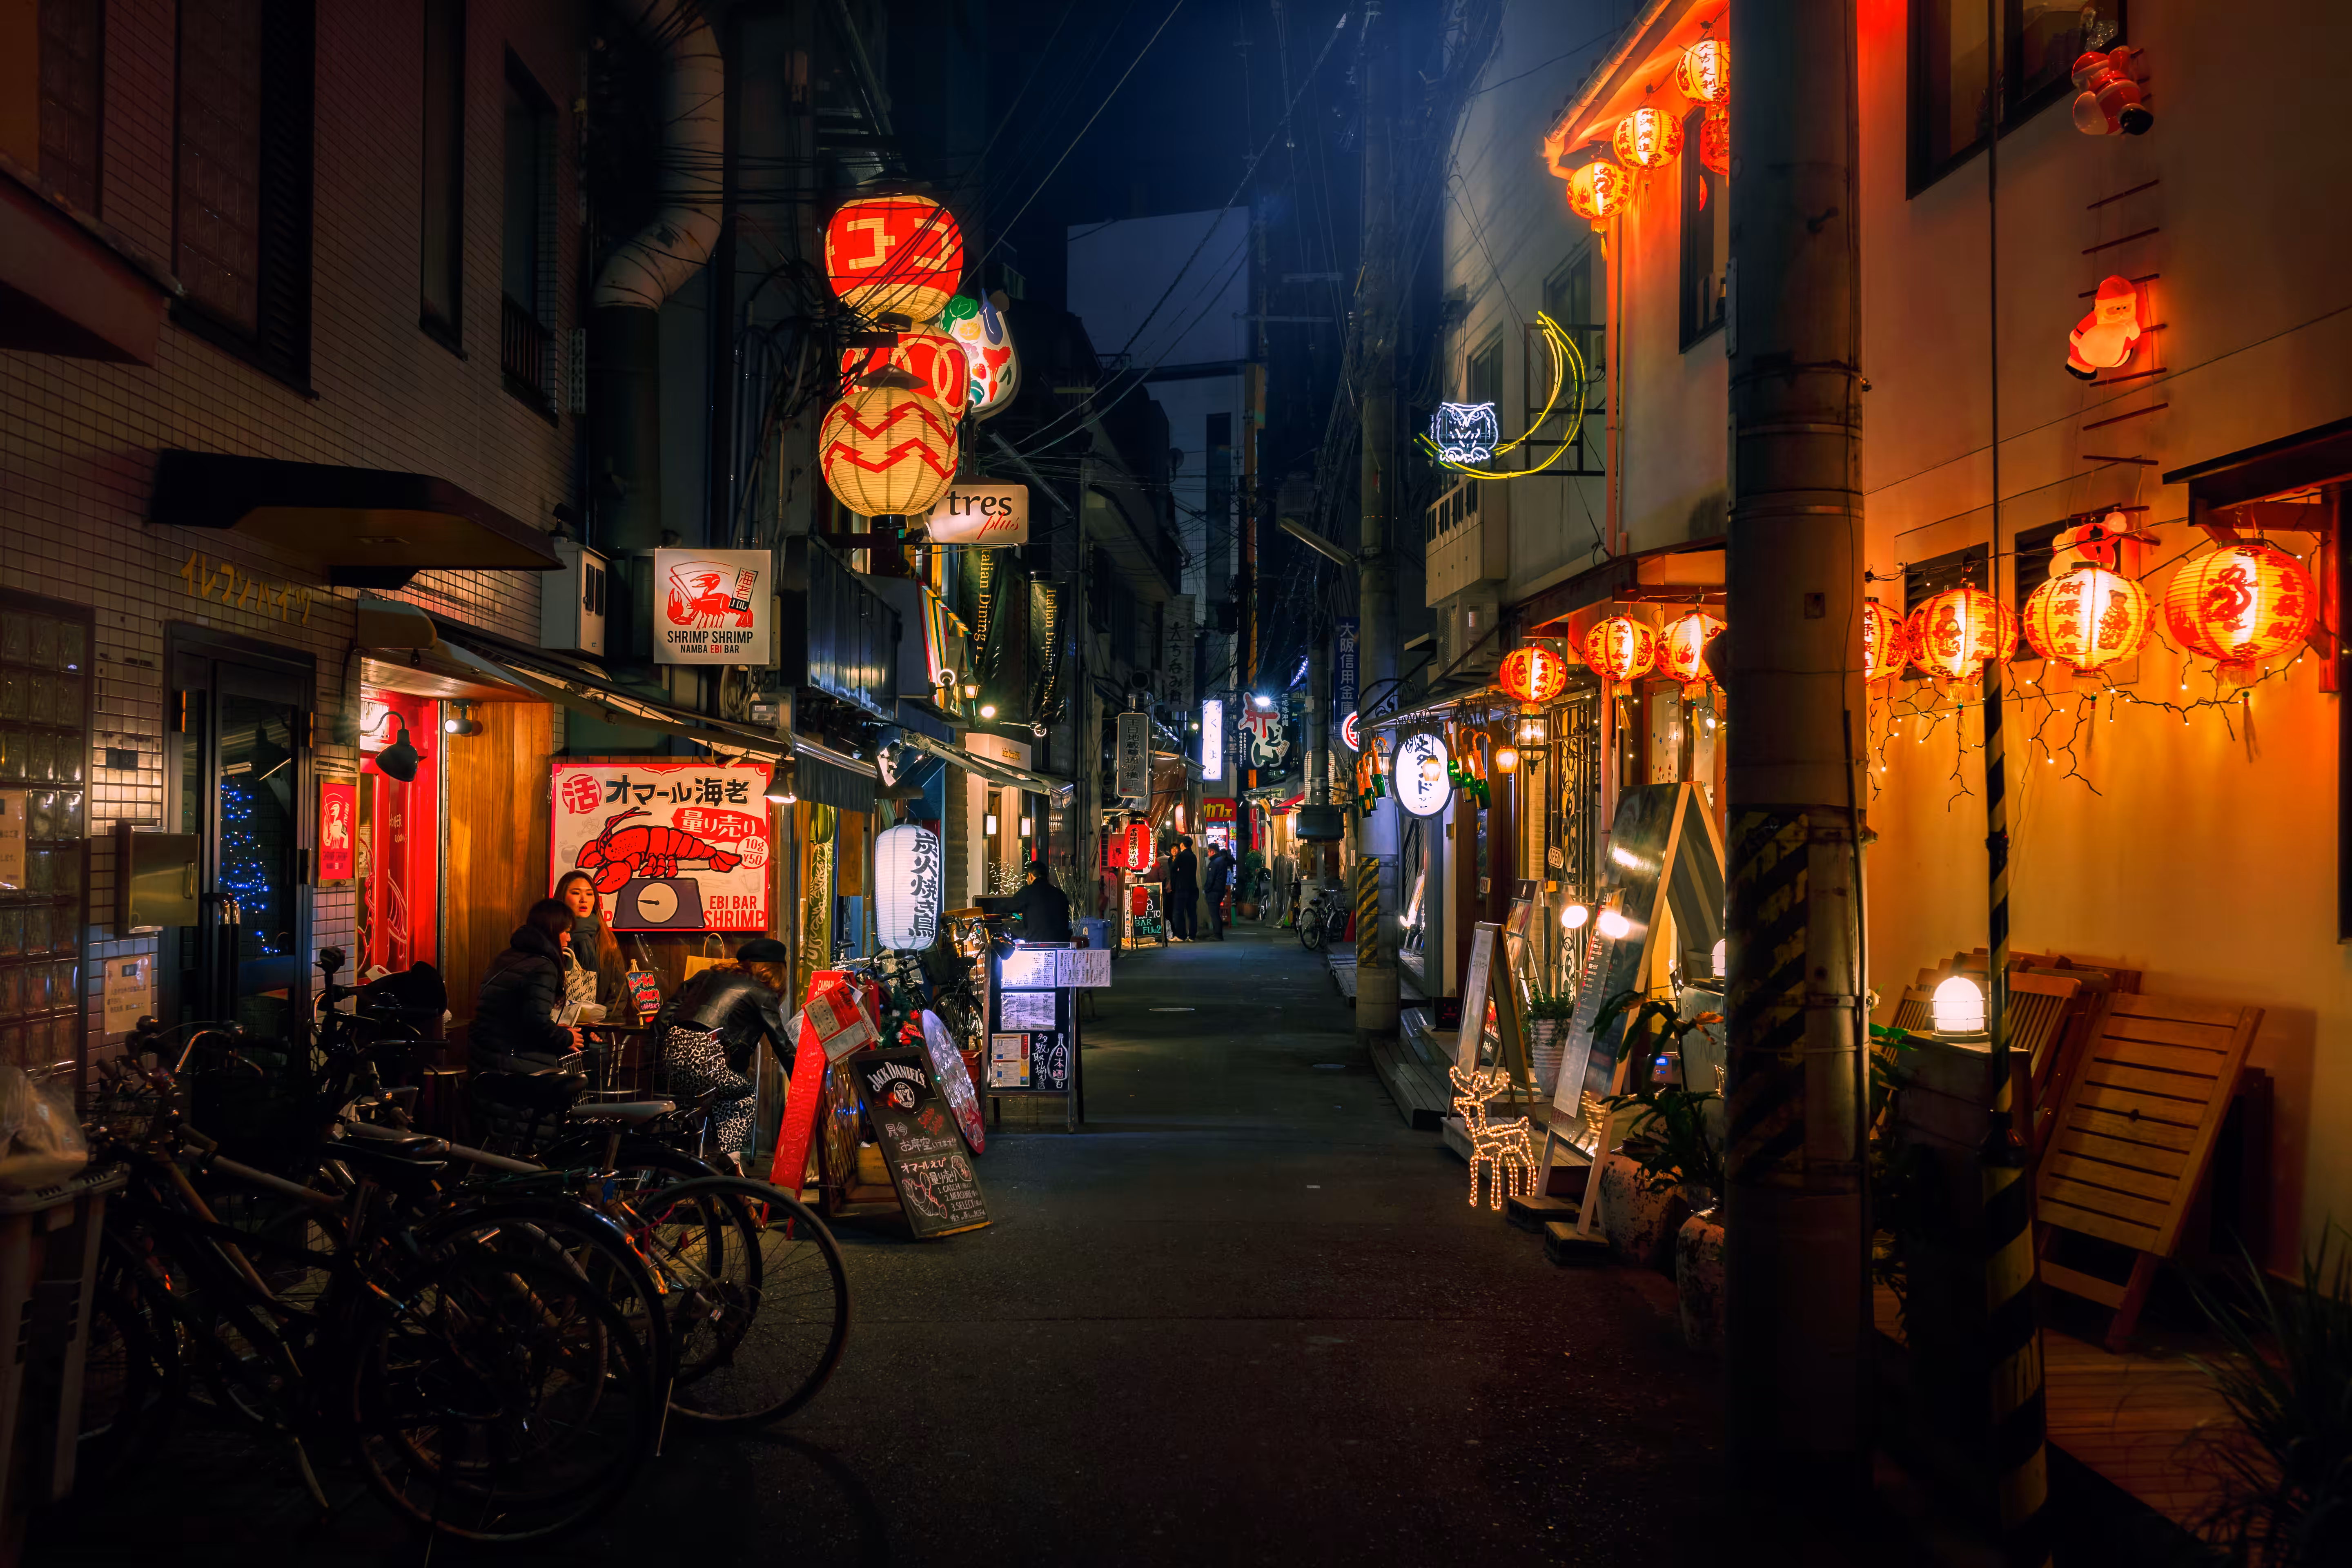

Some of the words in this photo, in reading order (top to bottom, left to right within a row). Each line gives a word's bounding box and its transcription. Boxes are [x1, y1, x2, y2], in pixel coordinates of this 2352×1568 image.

[1698, 44, 1717, 89] 大吉大利
[947, 490, 1012, 516] tres
[976, 511, 1020, 540] plus
[979, 549, 993, 588] talian
[974, 593, 991, 641] Dining
[1046, 588, 1057, 628] Italian
[667, 631, 709, 643] SHRIMP
[712, 631, 753, 644] SHRIMP
[681, 645, 708, 653] NAMBA
[710, 645, 722, 653] EBI
[724, 645, 739, 653] BAR
[1042, 631, 1056, 672] Dining
[1340, 622, 1355, 716] 大阪信用金庫
[562, 775, 600, 814] 活
[605, 774, 751, 806] オマール海老
[681, 810, 756, 837] 量り売り
[745, 838, 764, 852] 10g
[1549, 849, 1561, 865] OPEN
[743, 854, 763, 865] ¥50
[908, 832, 939, 939] 炭火焼き鳥
[710, 895, 729, 909] EBI
[733, 895, 757, 909] BAR
[704, 910, 764, 927] SHRIMP
[867, 1067, 890, 1092] JACK
[884, 1062, 926, 1087] DANIEL'S
[885, 1122, 908, 1137] 只今
[900, 1156, 947, 1174] オマールえび
[929, 1169, 958, 1185] 量り売り
